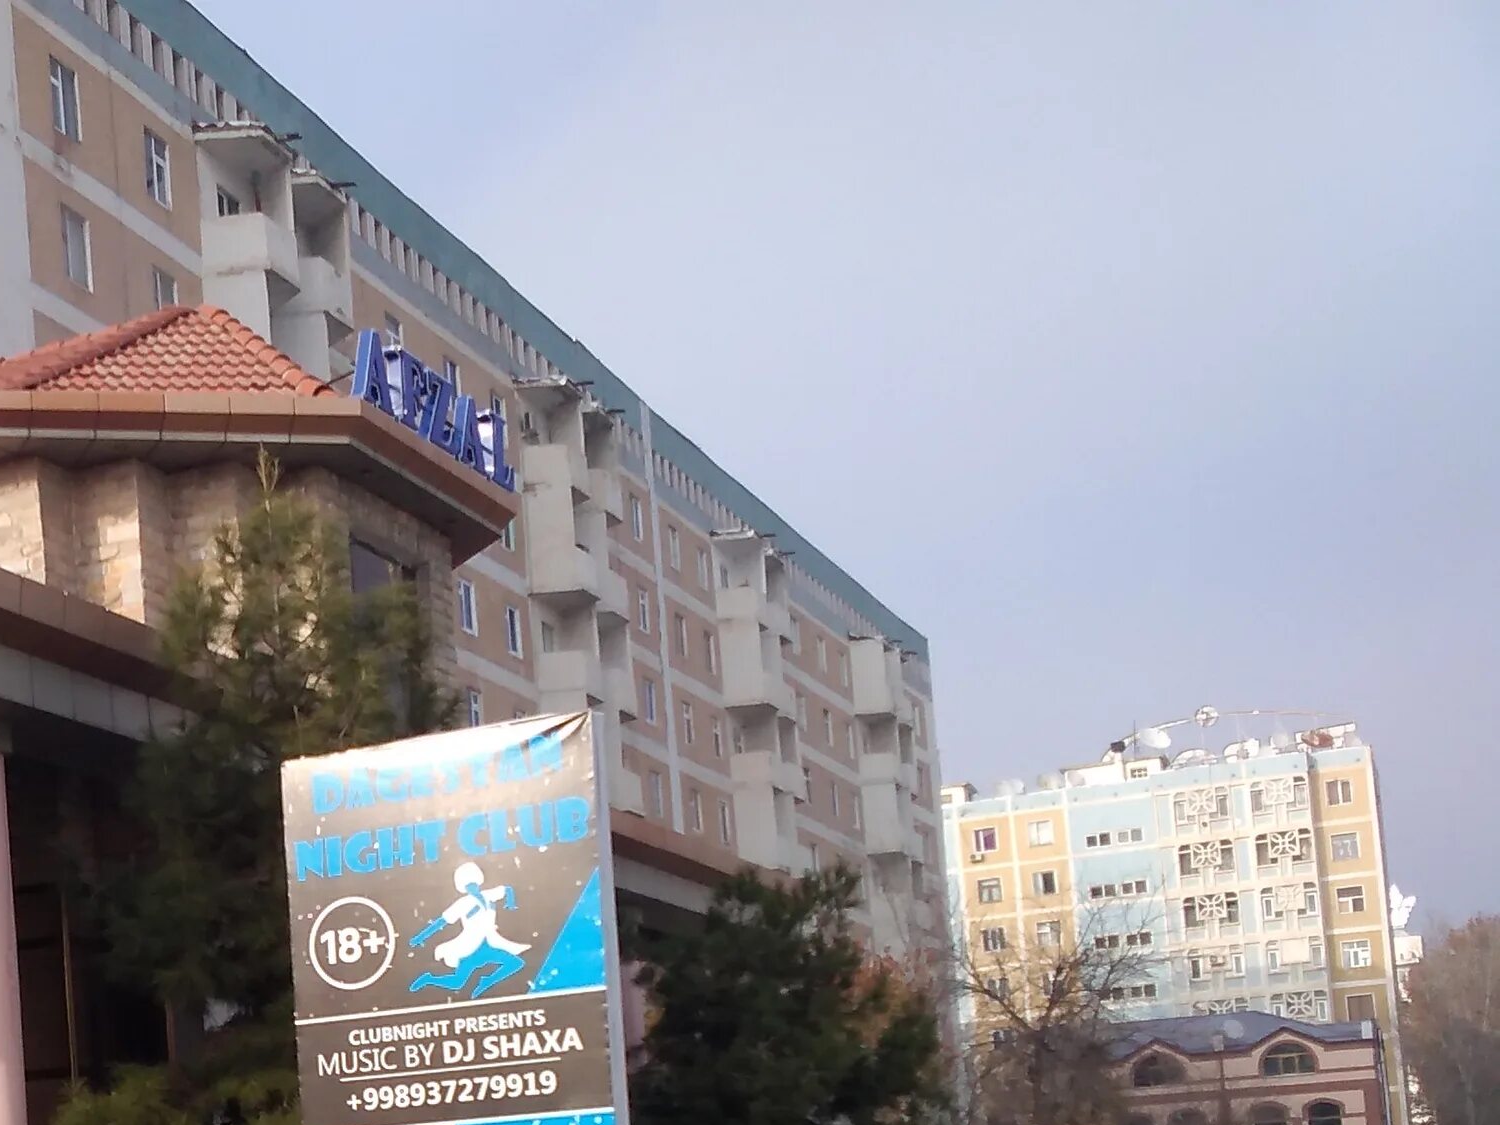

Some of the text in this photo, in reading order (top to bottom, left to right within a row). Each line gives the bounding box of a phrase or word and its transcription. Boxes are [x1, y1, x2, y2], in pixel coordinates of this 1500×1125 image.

[311, 733, 563, 815] DAGESTAN
[294, 796, 590, 882] NIGHT CLUB
[320, 927, 386, 965] 18+
[348, 1009, 546, 1046] CLUBNIGHT PRESENTS
[317, 1027, 584, 1076] MUSIC BY DJ SHAXA
[346, 1070, 558, 1111] +998937279919
